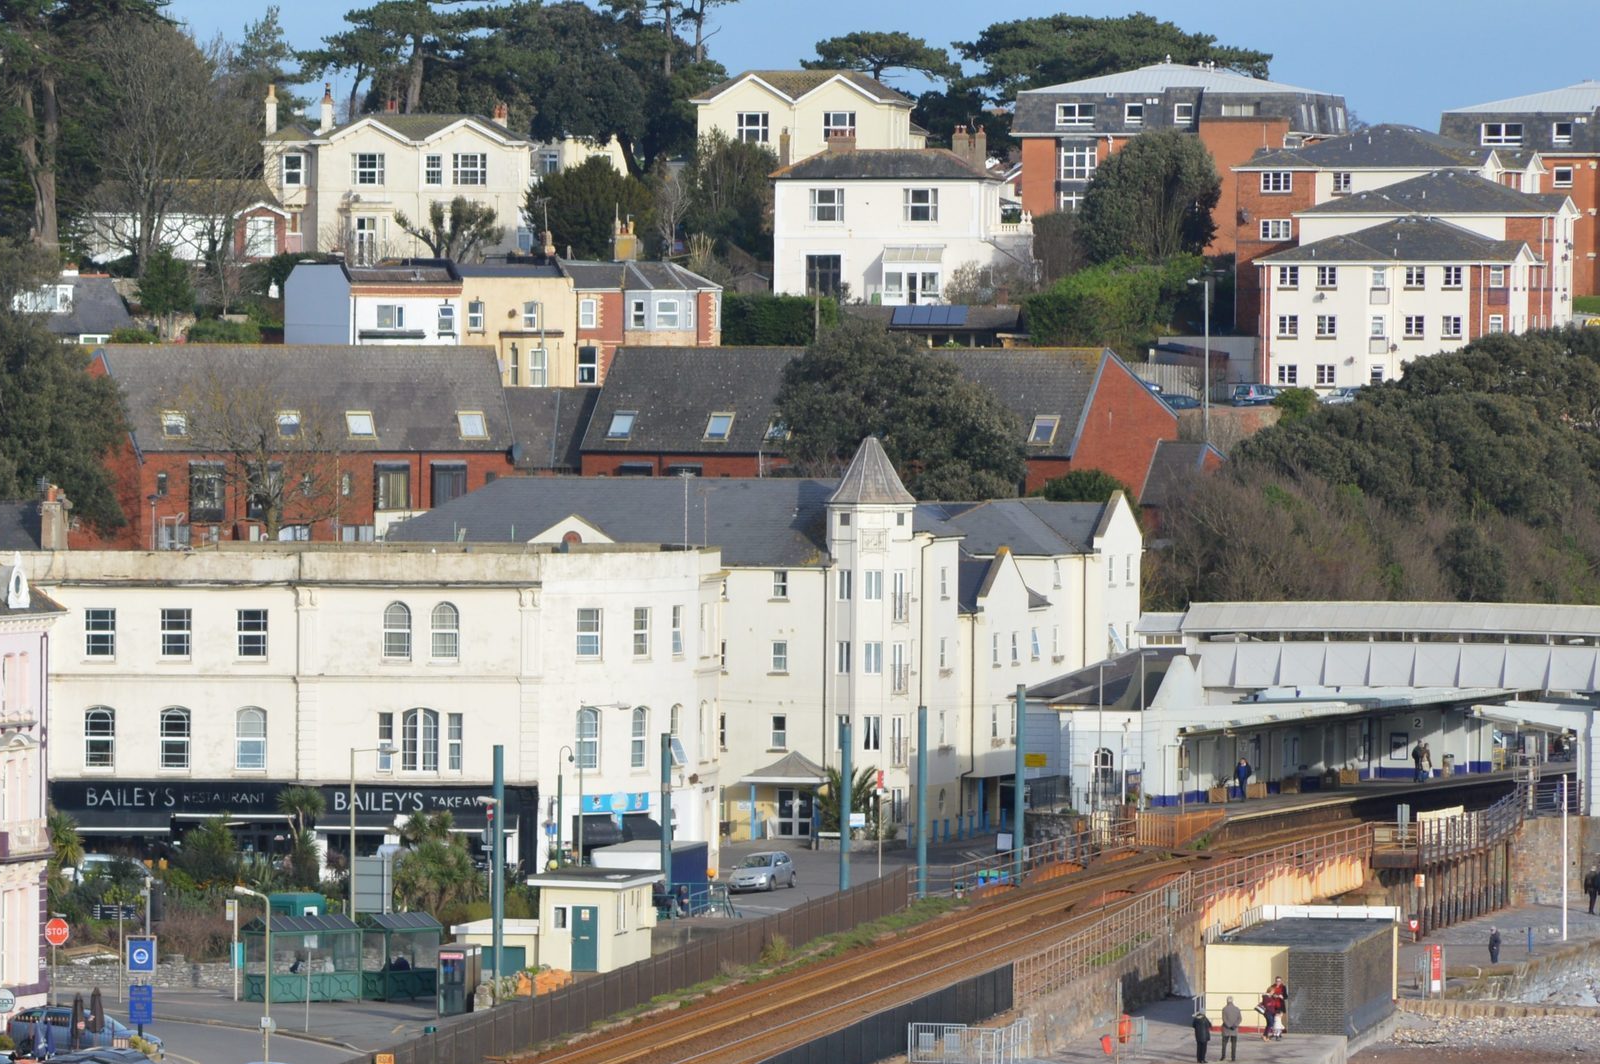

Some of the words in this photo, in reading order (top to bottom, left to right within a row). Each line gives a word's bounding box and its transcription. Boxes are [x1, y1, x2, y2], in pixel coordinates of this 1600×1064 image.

[1414, 718, 1422, 728] 2
[86, 787, 176, 807] BAILEY'S
[183, 791, 265, 804] RESTAURANT
[334, 791, 424, 811] BAILEY'S
[431, 796, 492, 808] TAKEAW
[47, 927, 68, 936] STOP
